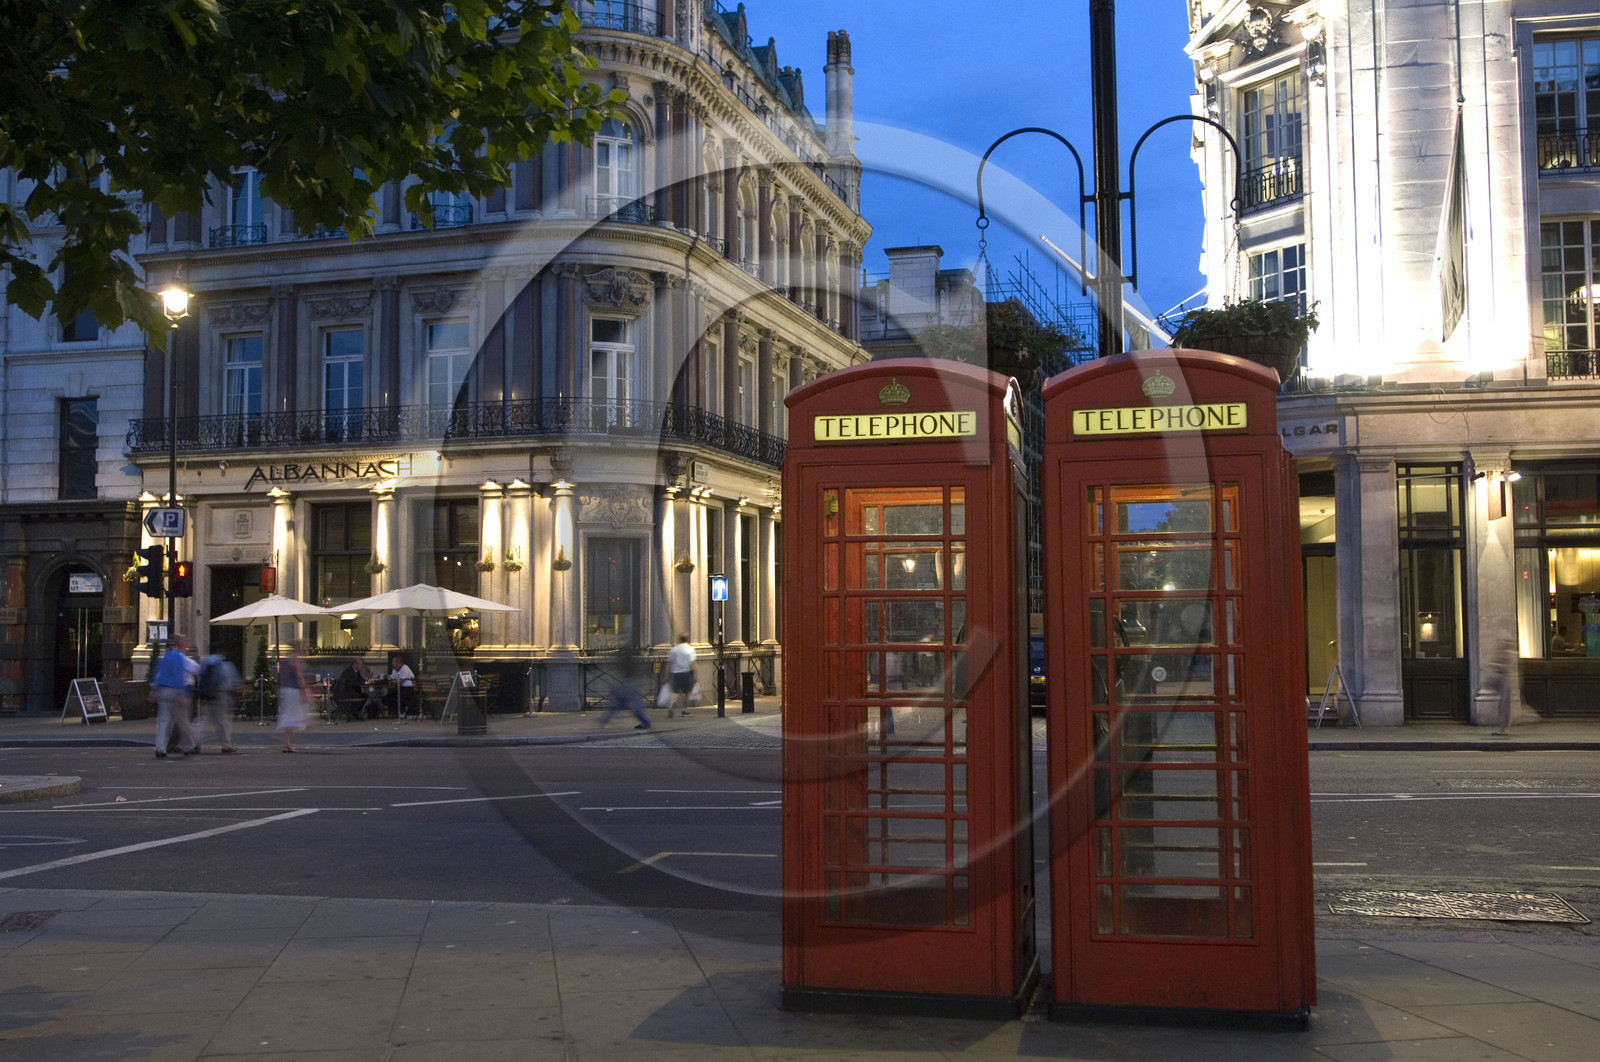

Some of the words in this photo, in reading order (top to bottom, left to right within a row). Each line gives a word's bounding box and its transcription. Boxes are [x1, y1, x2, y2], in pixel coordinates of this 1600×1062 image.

[819, 413, 971, 438] TELEPHONE
[1079, 405, 1241, 432] TELEPHONE
[243, 453, 413, 490] ALBANNACH
[165, 513, 176, 526] P
